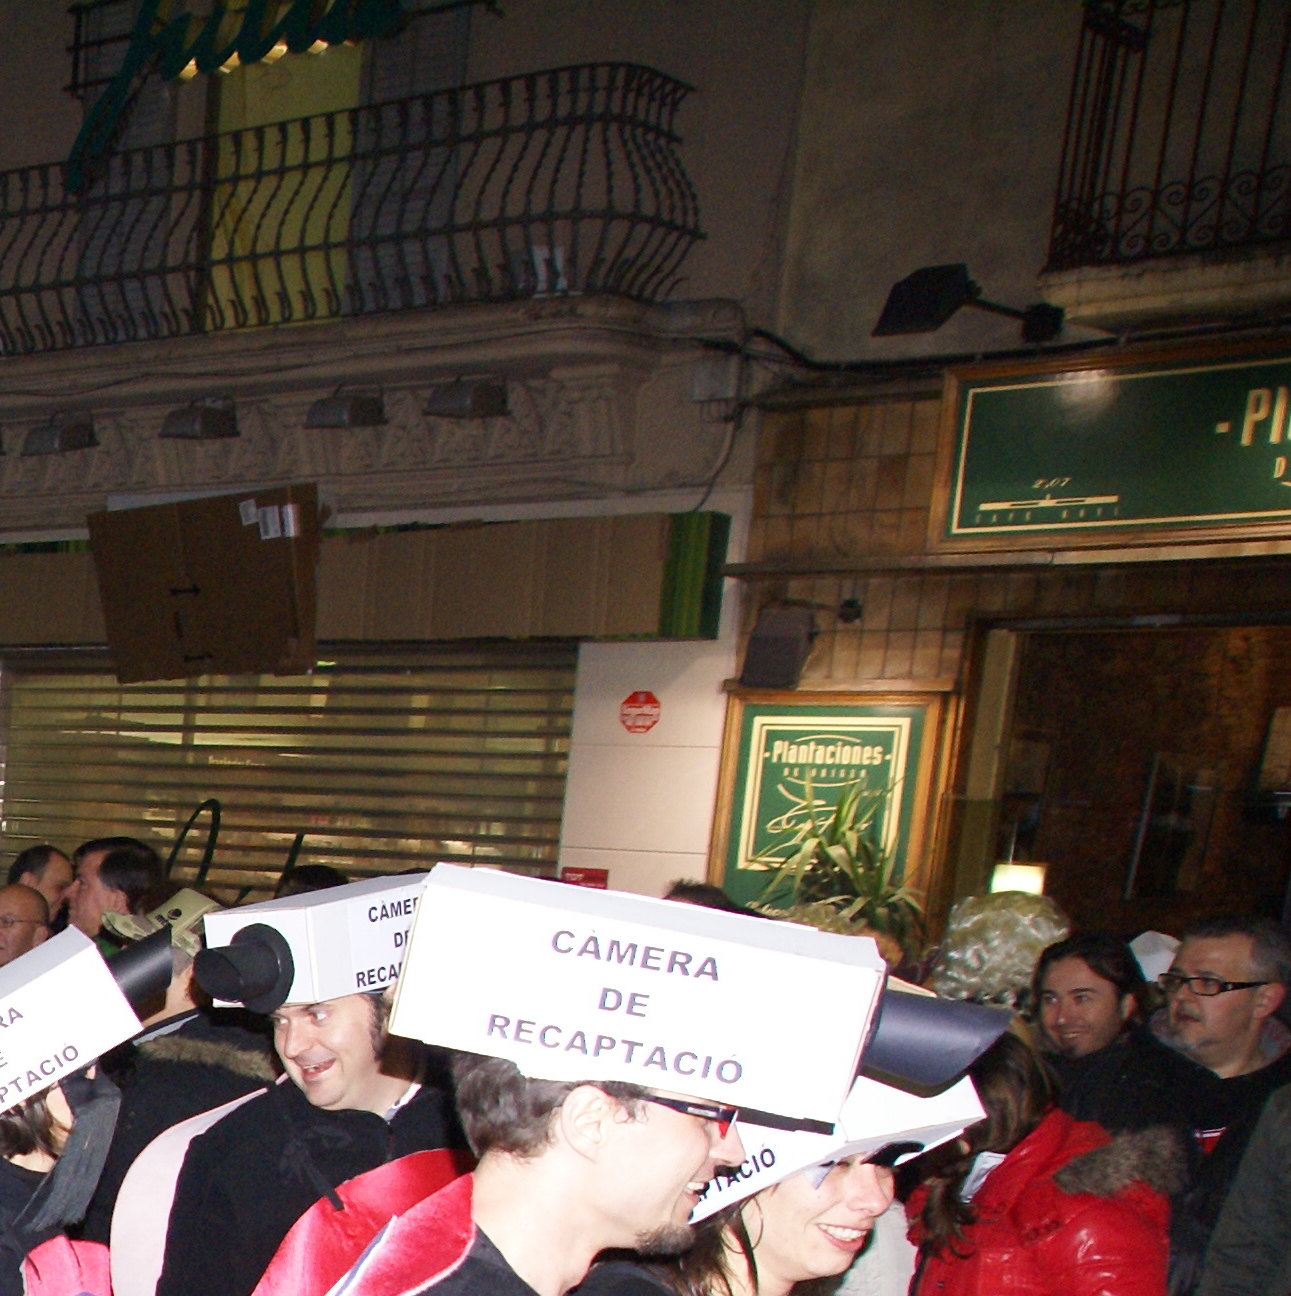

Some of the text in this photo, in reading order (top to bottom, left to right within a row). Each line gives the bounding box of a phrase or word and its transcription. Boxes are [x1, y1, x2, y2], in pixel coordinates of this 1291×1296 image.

[1240, 385, 1291, 447] Pl
[772, 740, 884, 765] Plantaciones
[597, 986, 651, 1018] DE
[486, 1013, 743, 1084] RECAPTACIÓ
